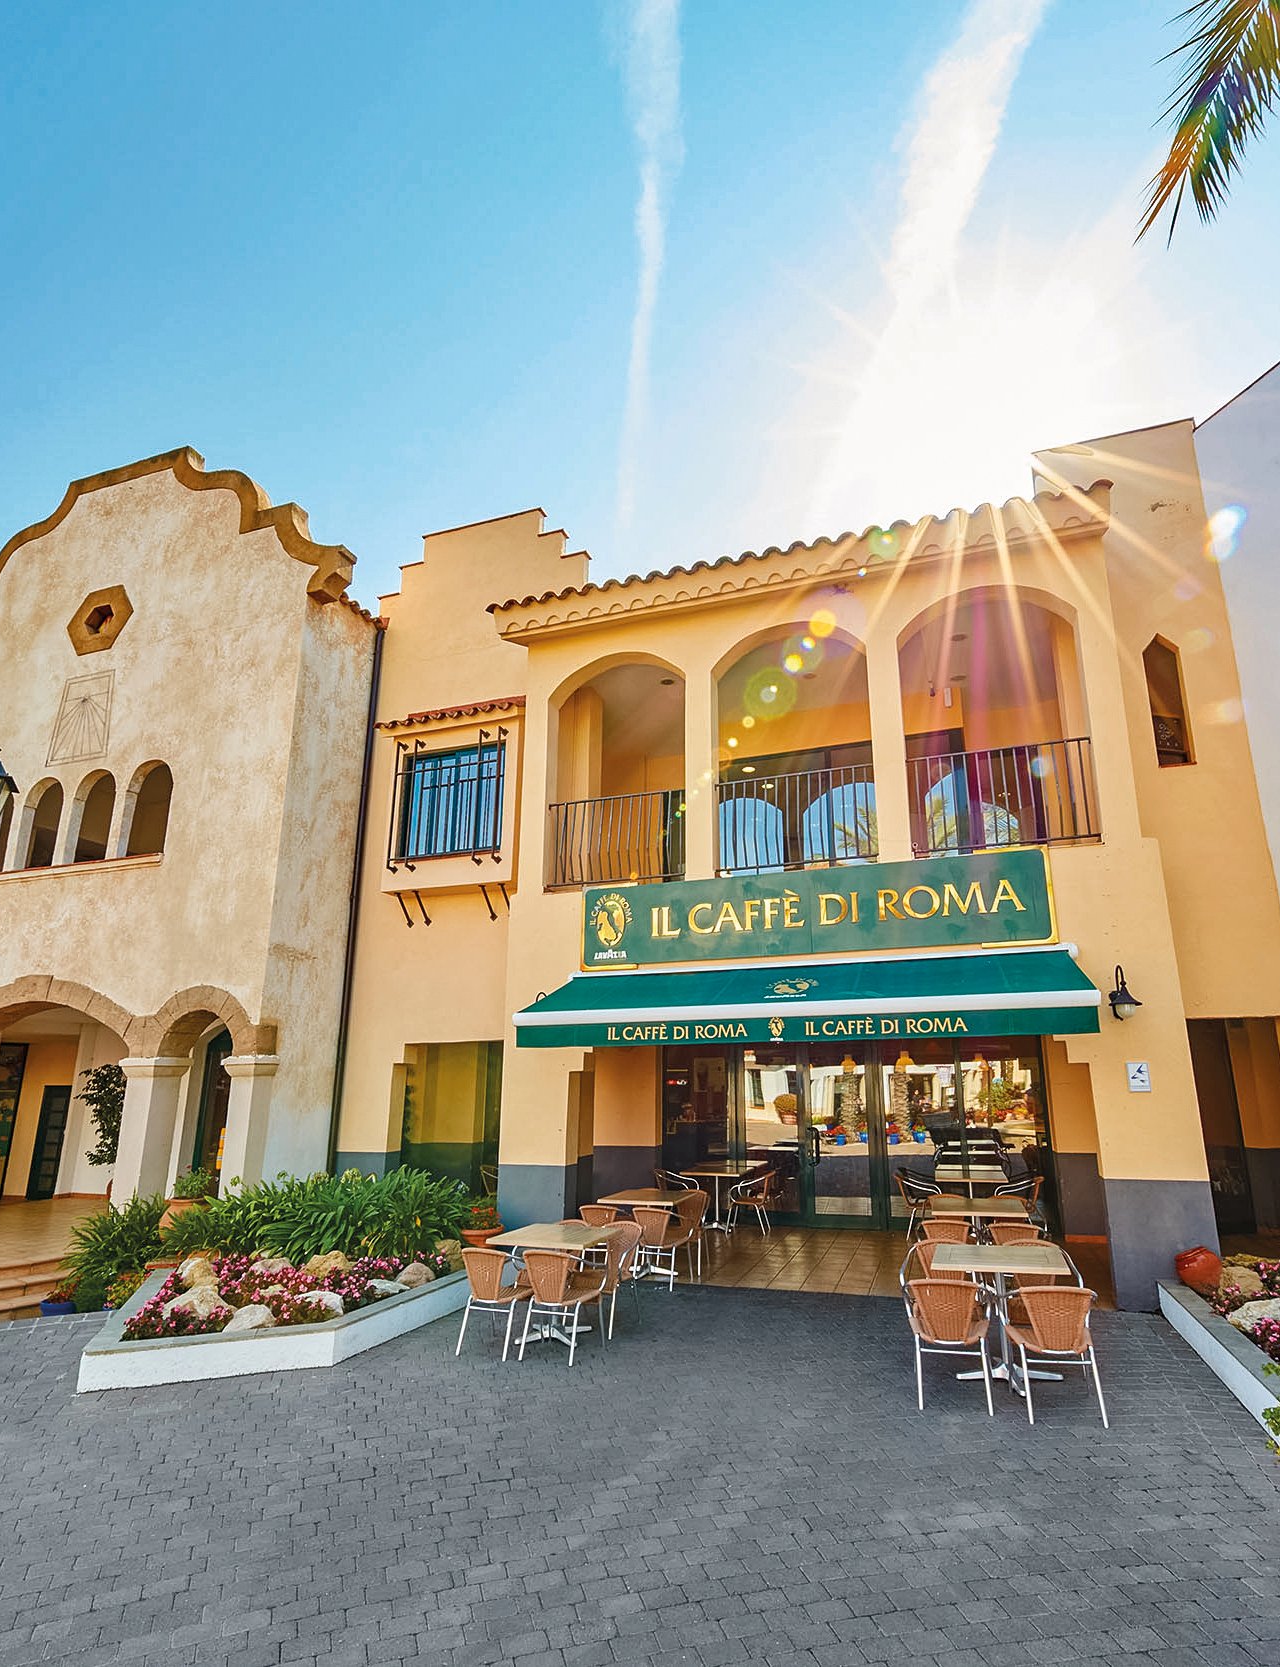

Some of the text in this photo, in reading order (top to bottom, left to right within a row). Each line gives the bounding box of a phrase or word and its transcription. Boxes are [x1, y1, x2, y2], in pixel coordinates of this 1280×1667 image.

[650, 879, 1027, 937] IL CAFFÈ DI ROMA
[607, 1023, 748, 1041] IL CAFFÈ DI ROMA
[805, 1016, 968, 1036] IL CAFFÈ DI ROMA
